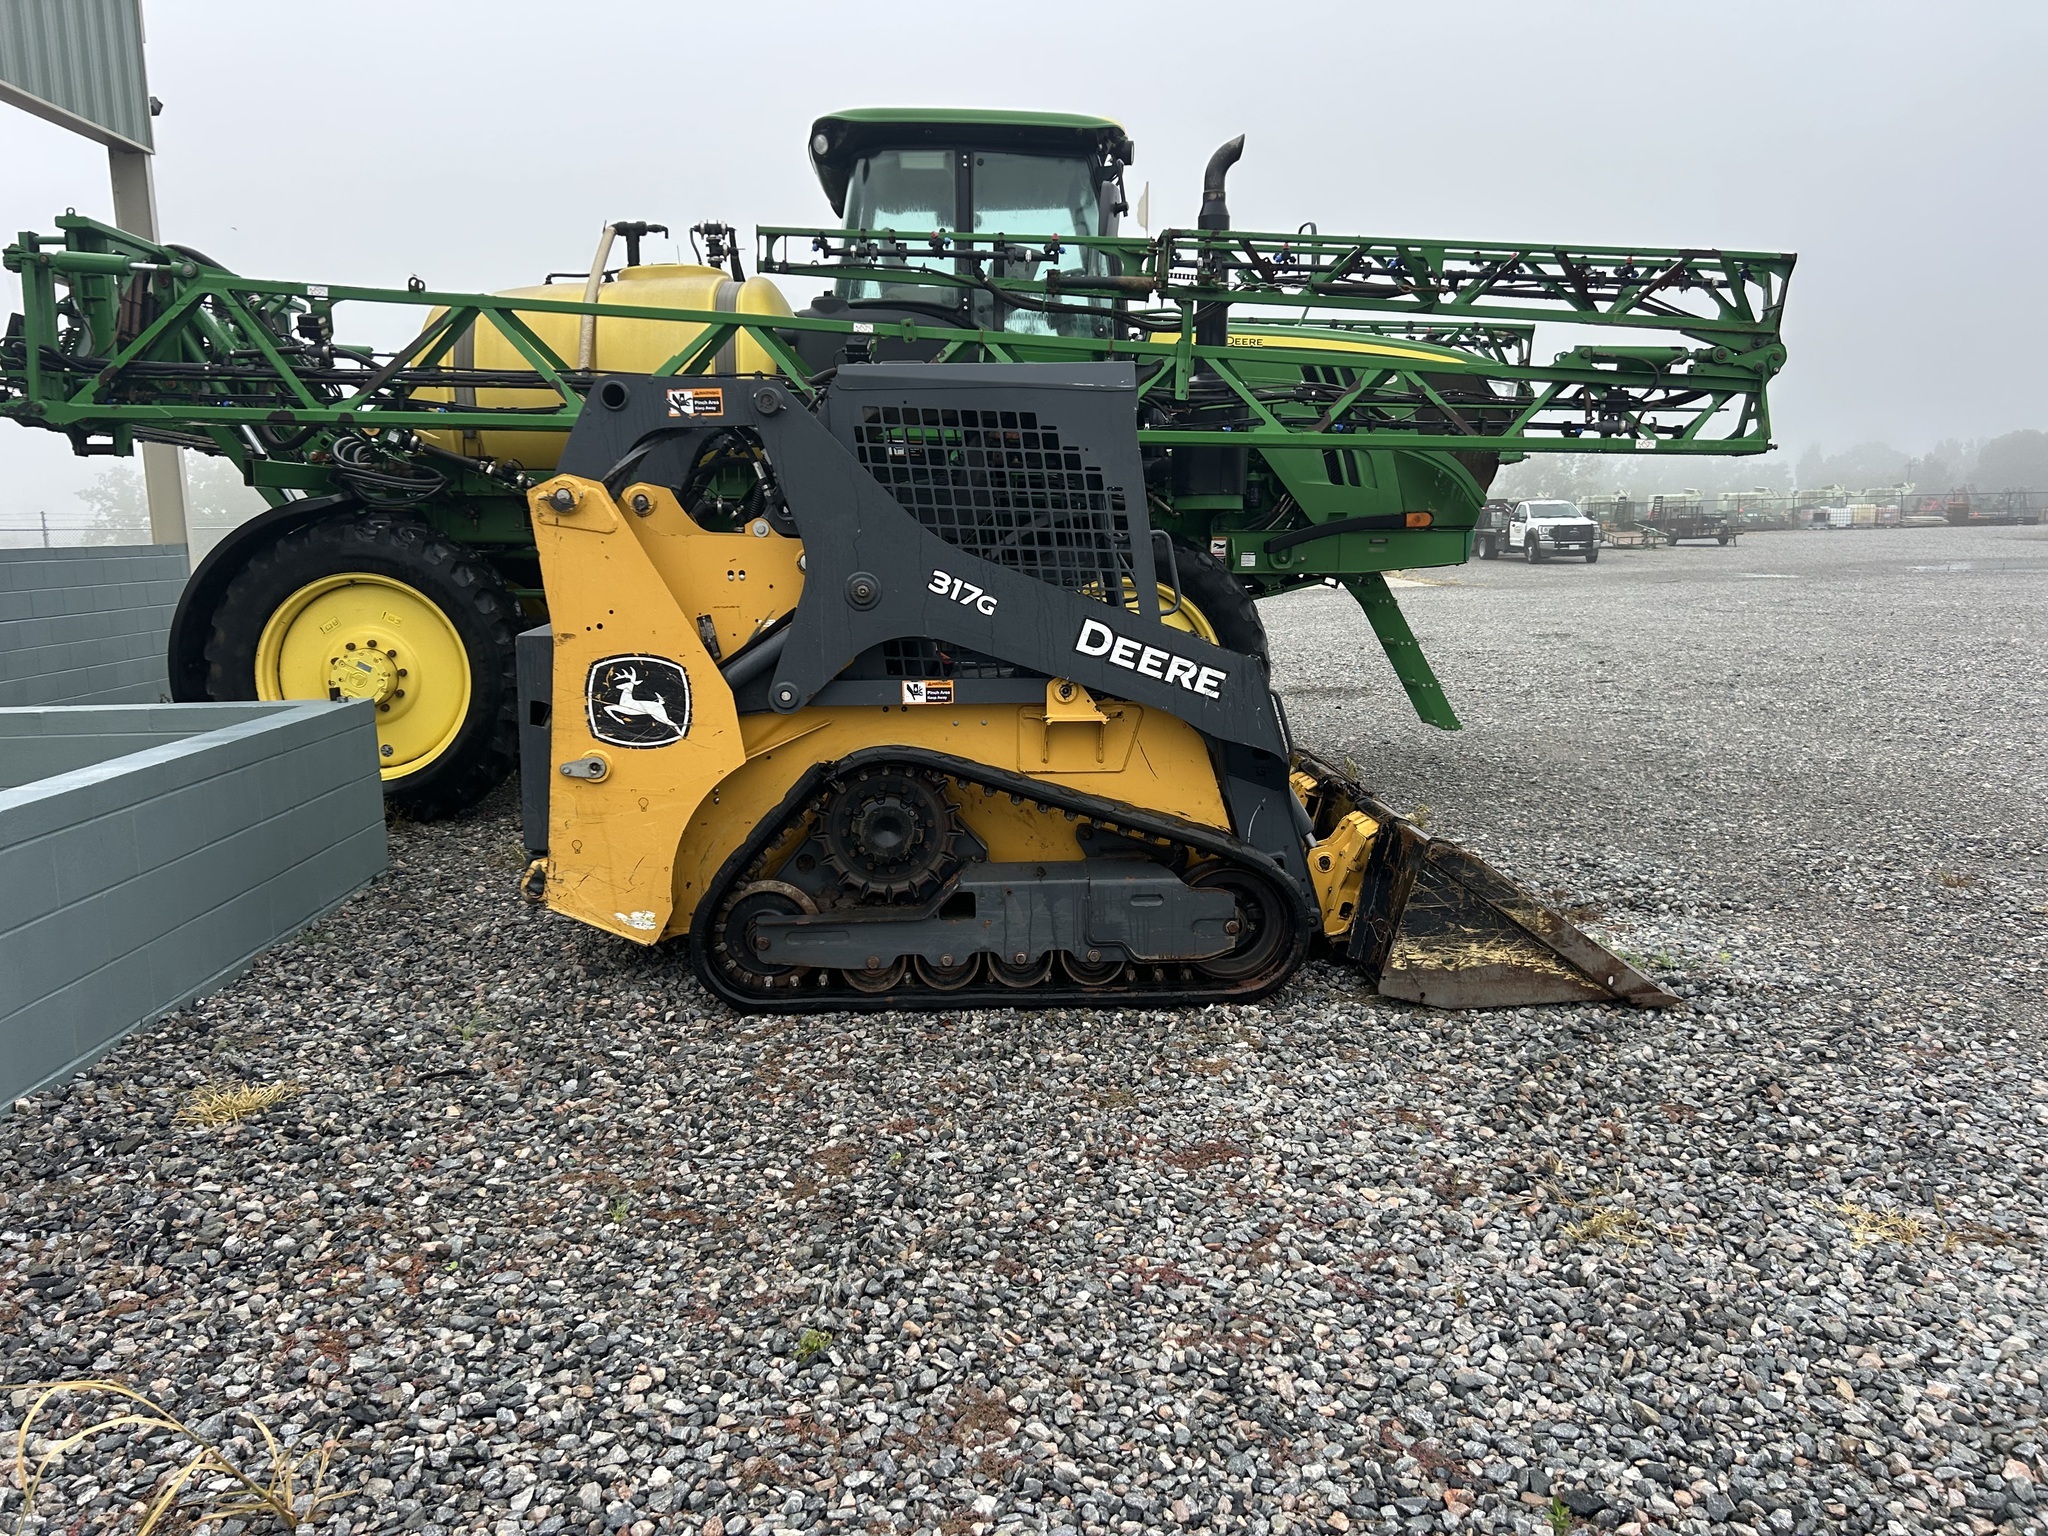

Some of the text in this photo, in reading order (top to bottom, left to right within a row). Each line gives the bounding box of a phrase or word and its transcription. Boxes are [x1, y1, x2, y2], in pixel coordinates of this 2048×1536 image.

[1228, 336, 1263, 346] DEERE
[927, 570, 999, 616] 317G
[1075, 618, 1227, 699] DEERE
